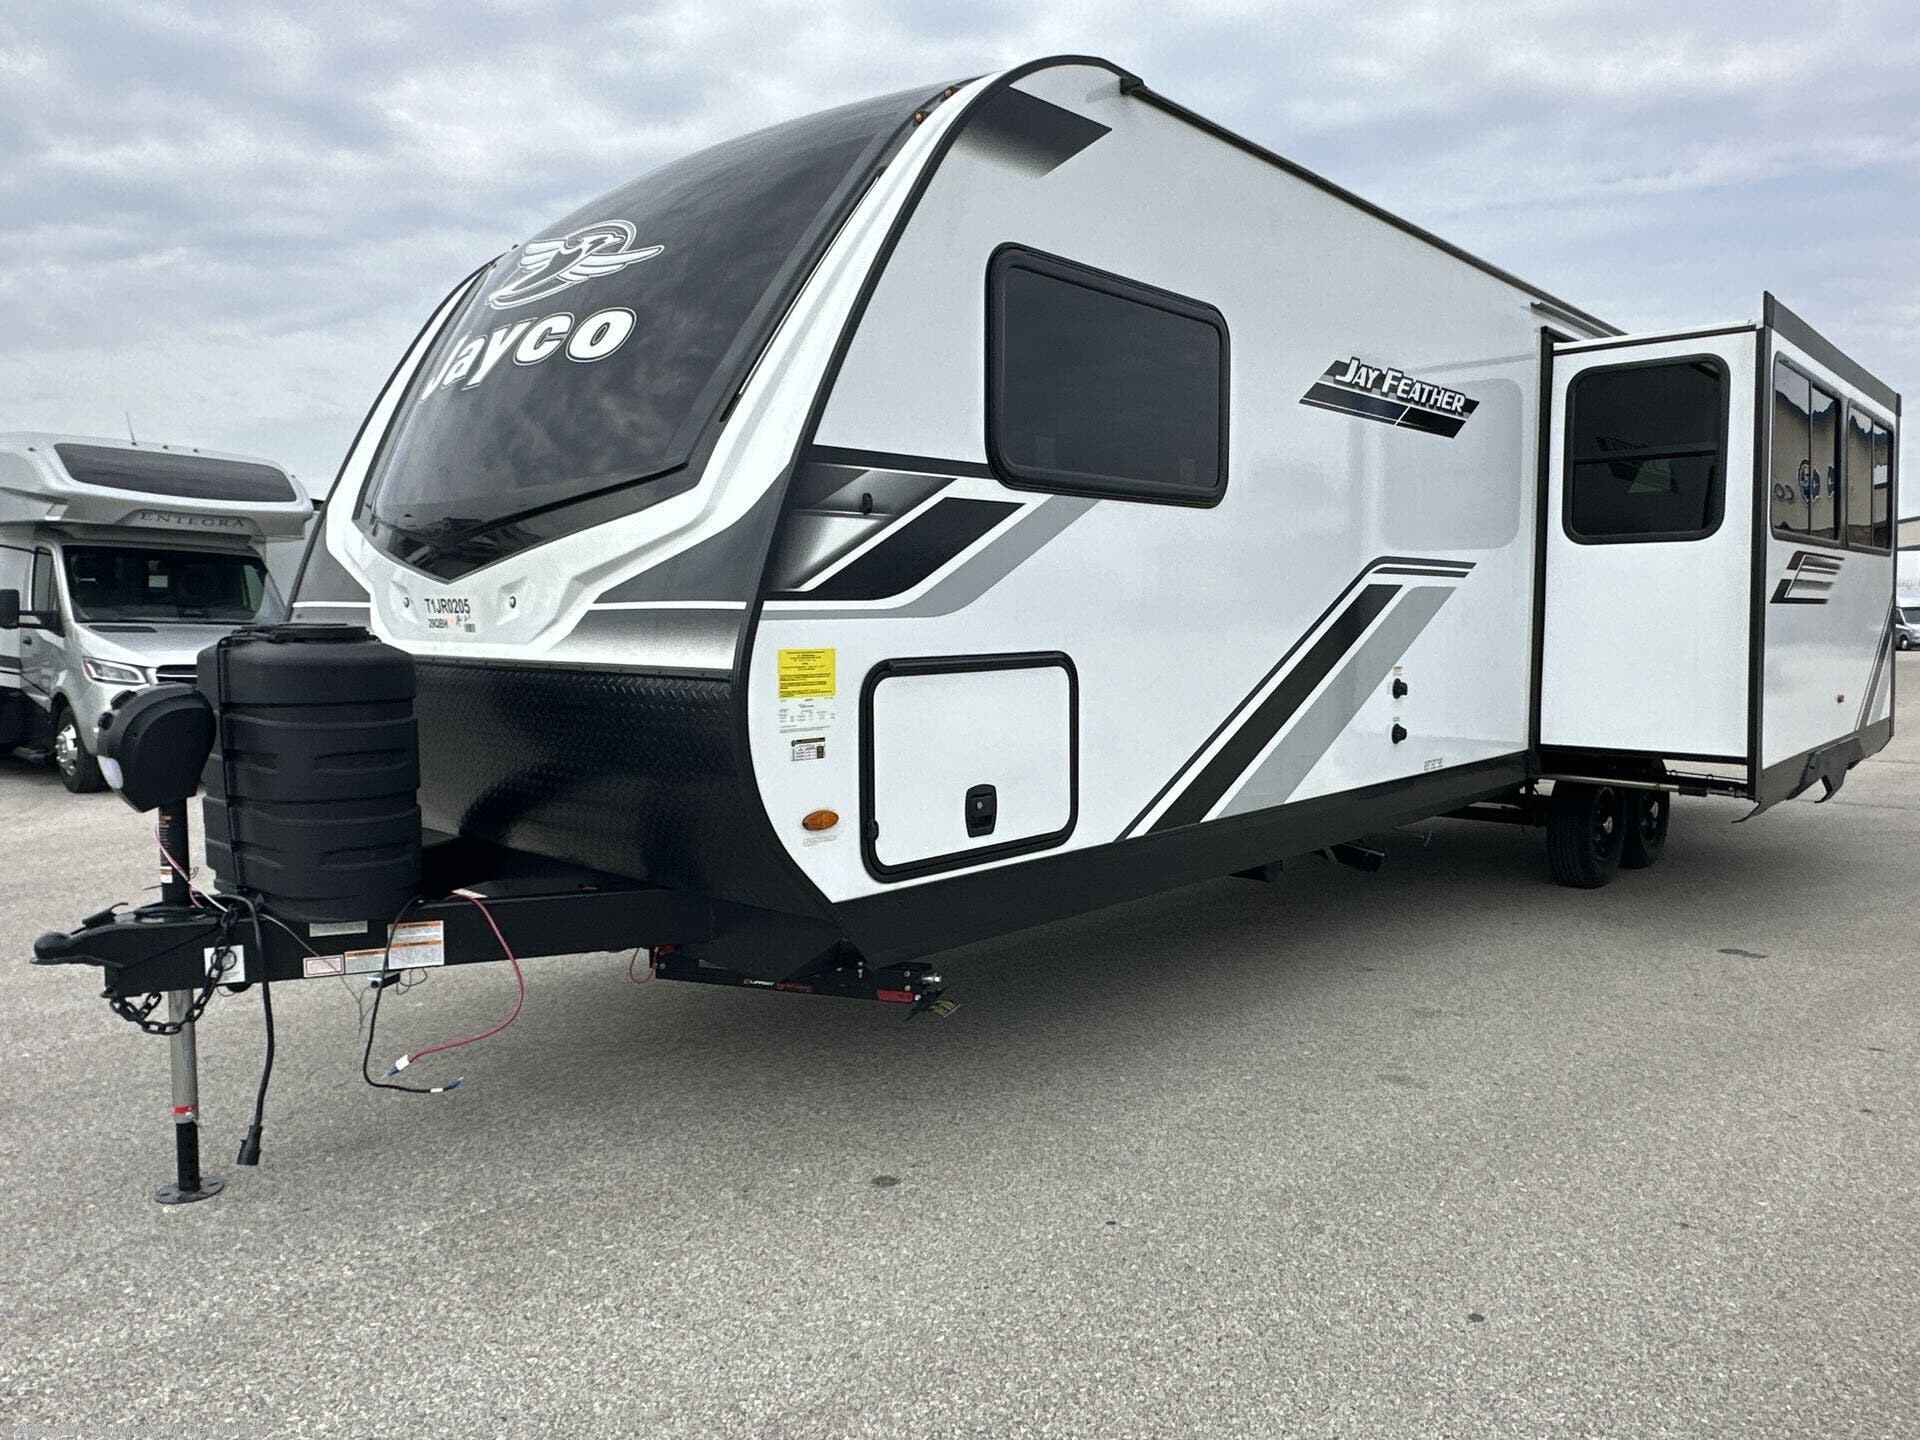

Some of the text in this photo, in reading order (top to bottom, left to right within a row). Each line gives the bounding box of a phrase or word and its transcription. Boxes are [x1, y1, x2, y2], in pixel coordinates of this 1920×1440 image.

[419, 307, 637, 403] Jayco
[1334, 357, 1466, 413] JAY FEATHER
[140, 511, 244, 527] ENTEGRA
[424, 598, 471, 614] T1JR0205
